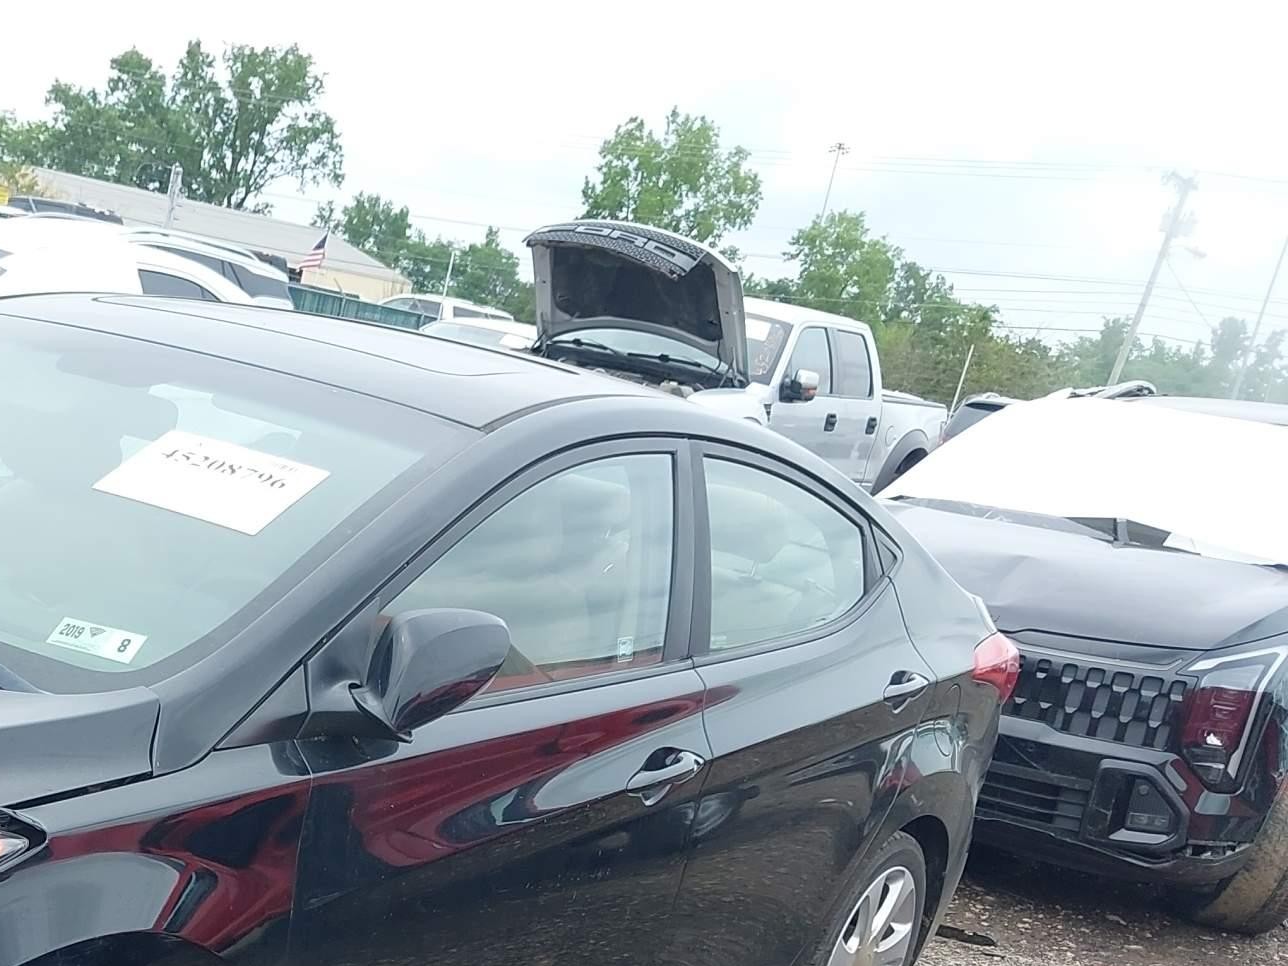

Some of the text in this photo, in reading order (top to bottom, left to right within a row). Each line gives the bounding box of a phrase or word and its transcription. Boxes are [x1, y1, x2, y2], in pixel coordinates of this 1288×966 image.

[161, 449, 287, 489] 45208796
[59, 623, 86, 639] 2019
[117, 638, 132, 653] 8
